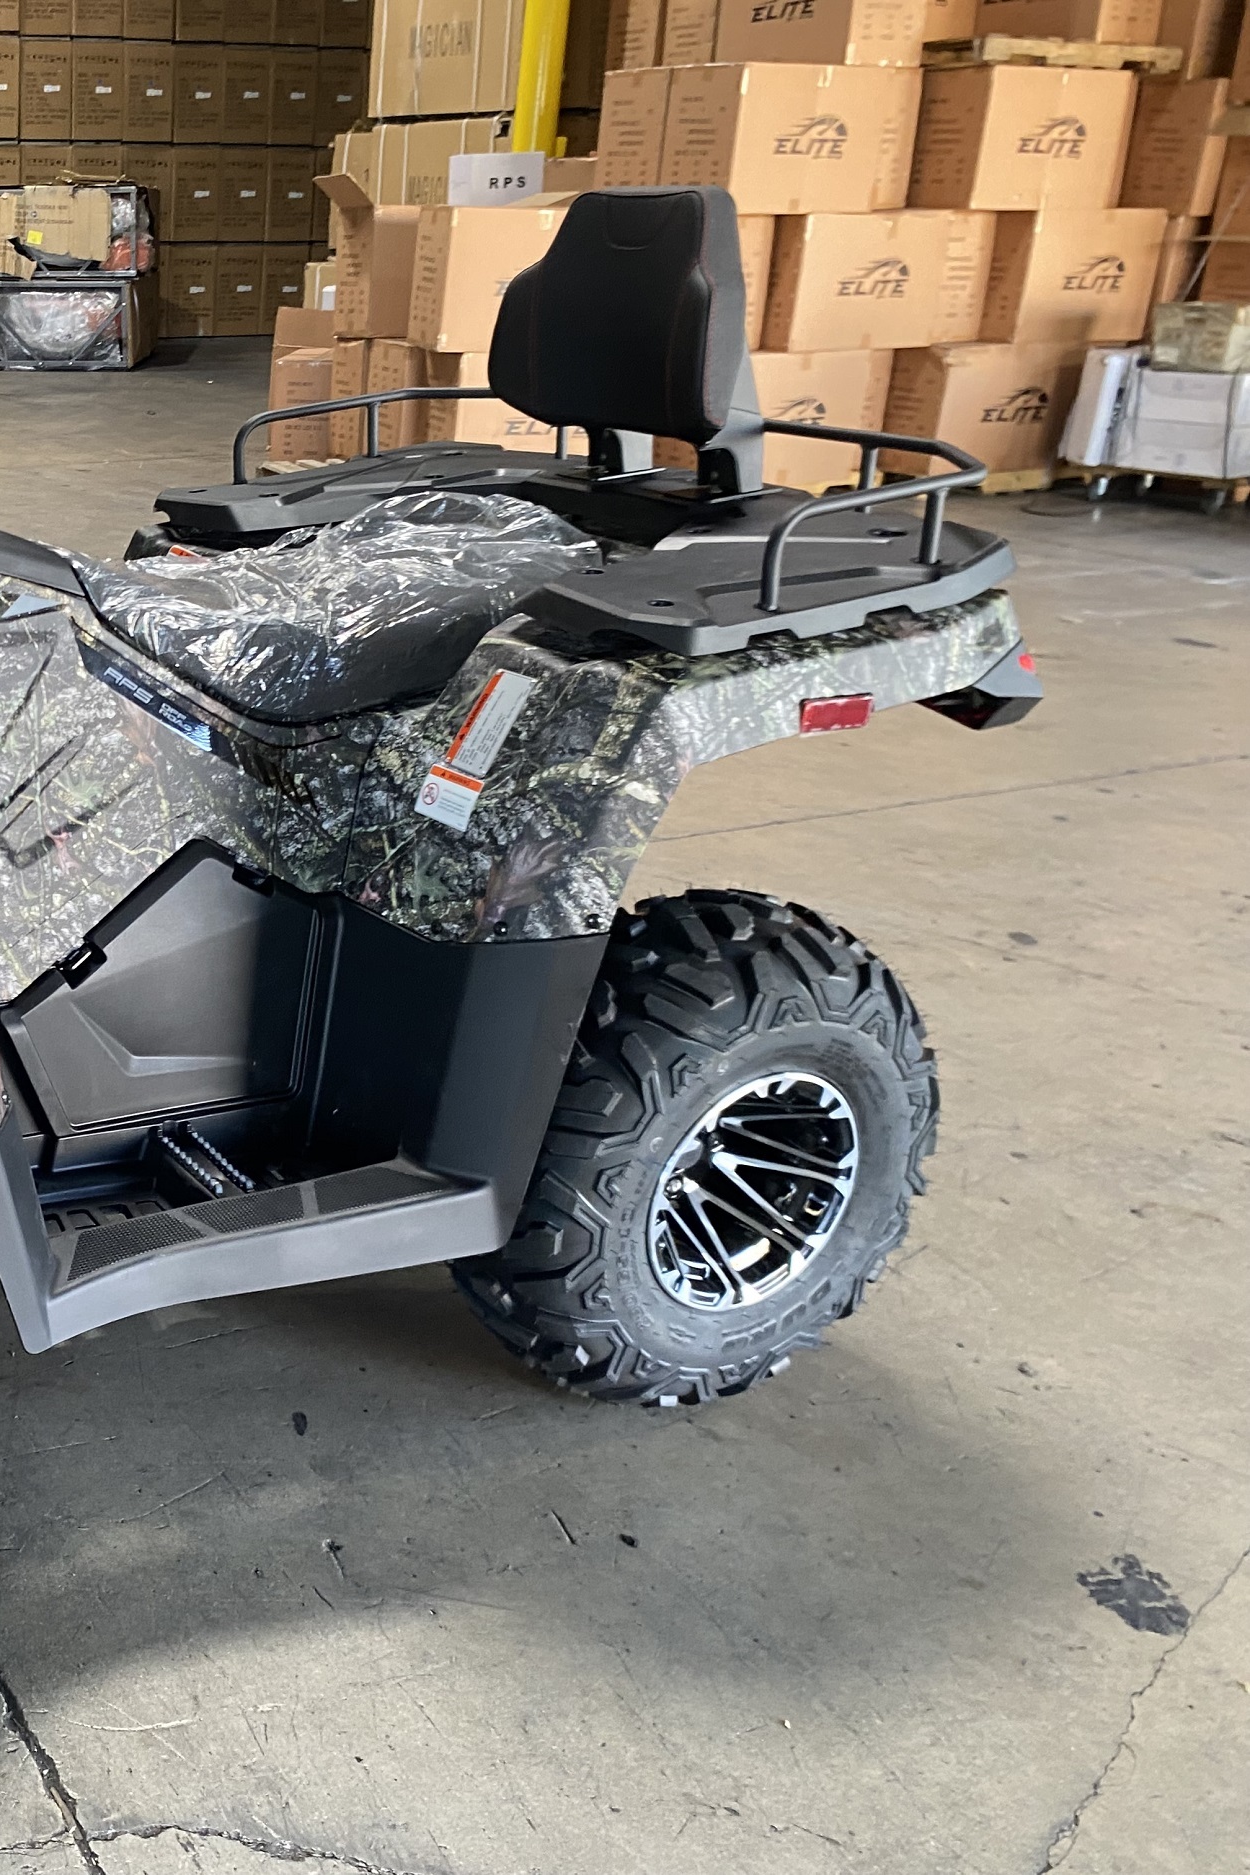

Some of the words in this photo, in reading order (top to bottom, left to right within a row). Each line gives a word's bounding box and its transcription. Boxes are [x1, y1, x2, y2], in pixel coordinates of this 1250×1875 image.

[751, 0, 815, 23] ELITE
[773, 138, 847, 159] ELITE
[1017, 138, 1086, 158] ELITE
[837, 279, 908, 299] ELITE
[1062, 275, 1124, 294] ELITE
[981, 405, 1048, 425] ELITE
[103, 666, 154, 704] RPS
[158, 709, 193, 732] ROAD
[160, 702, 187, 721] OFF
